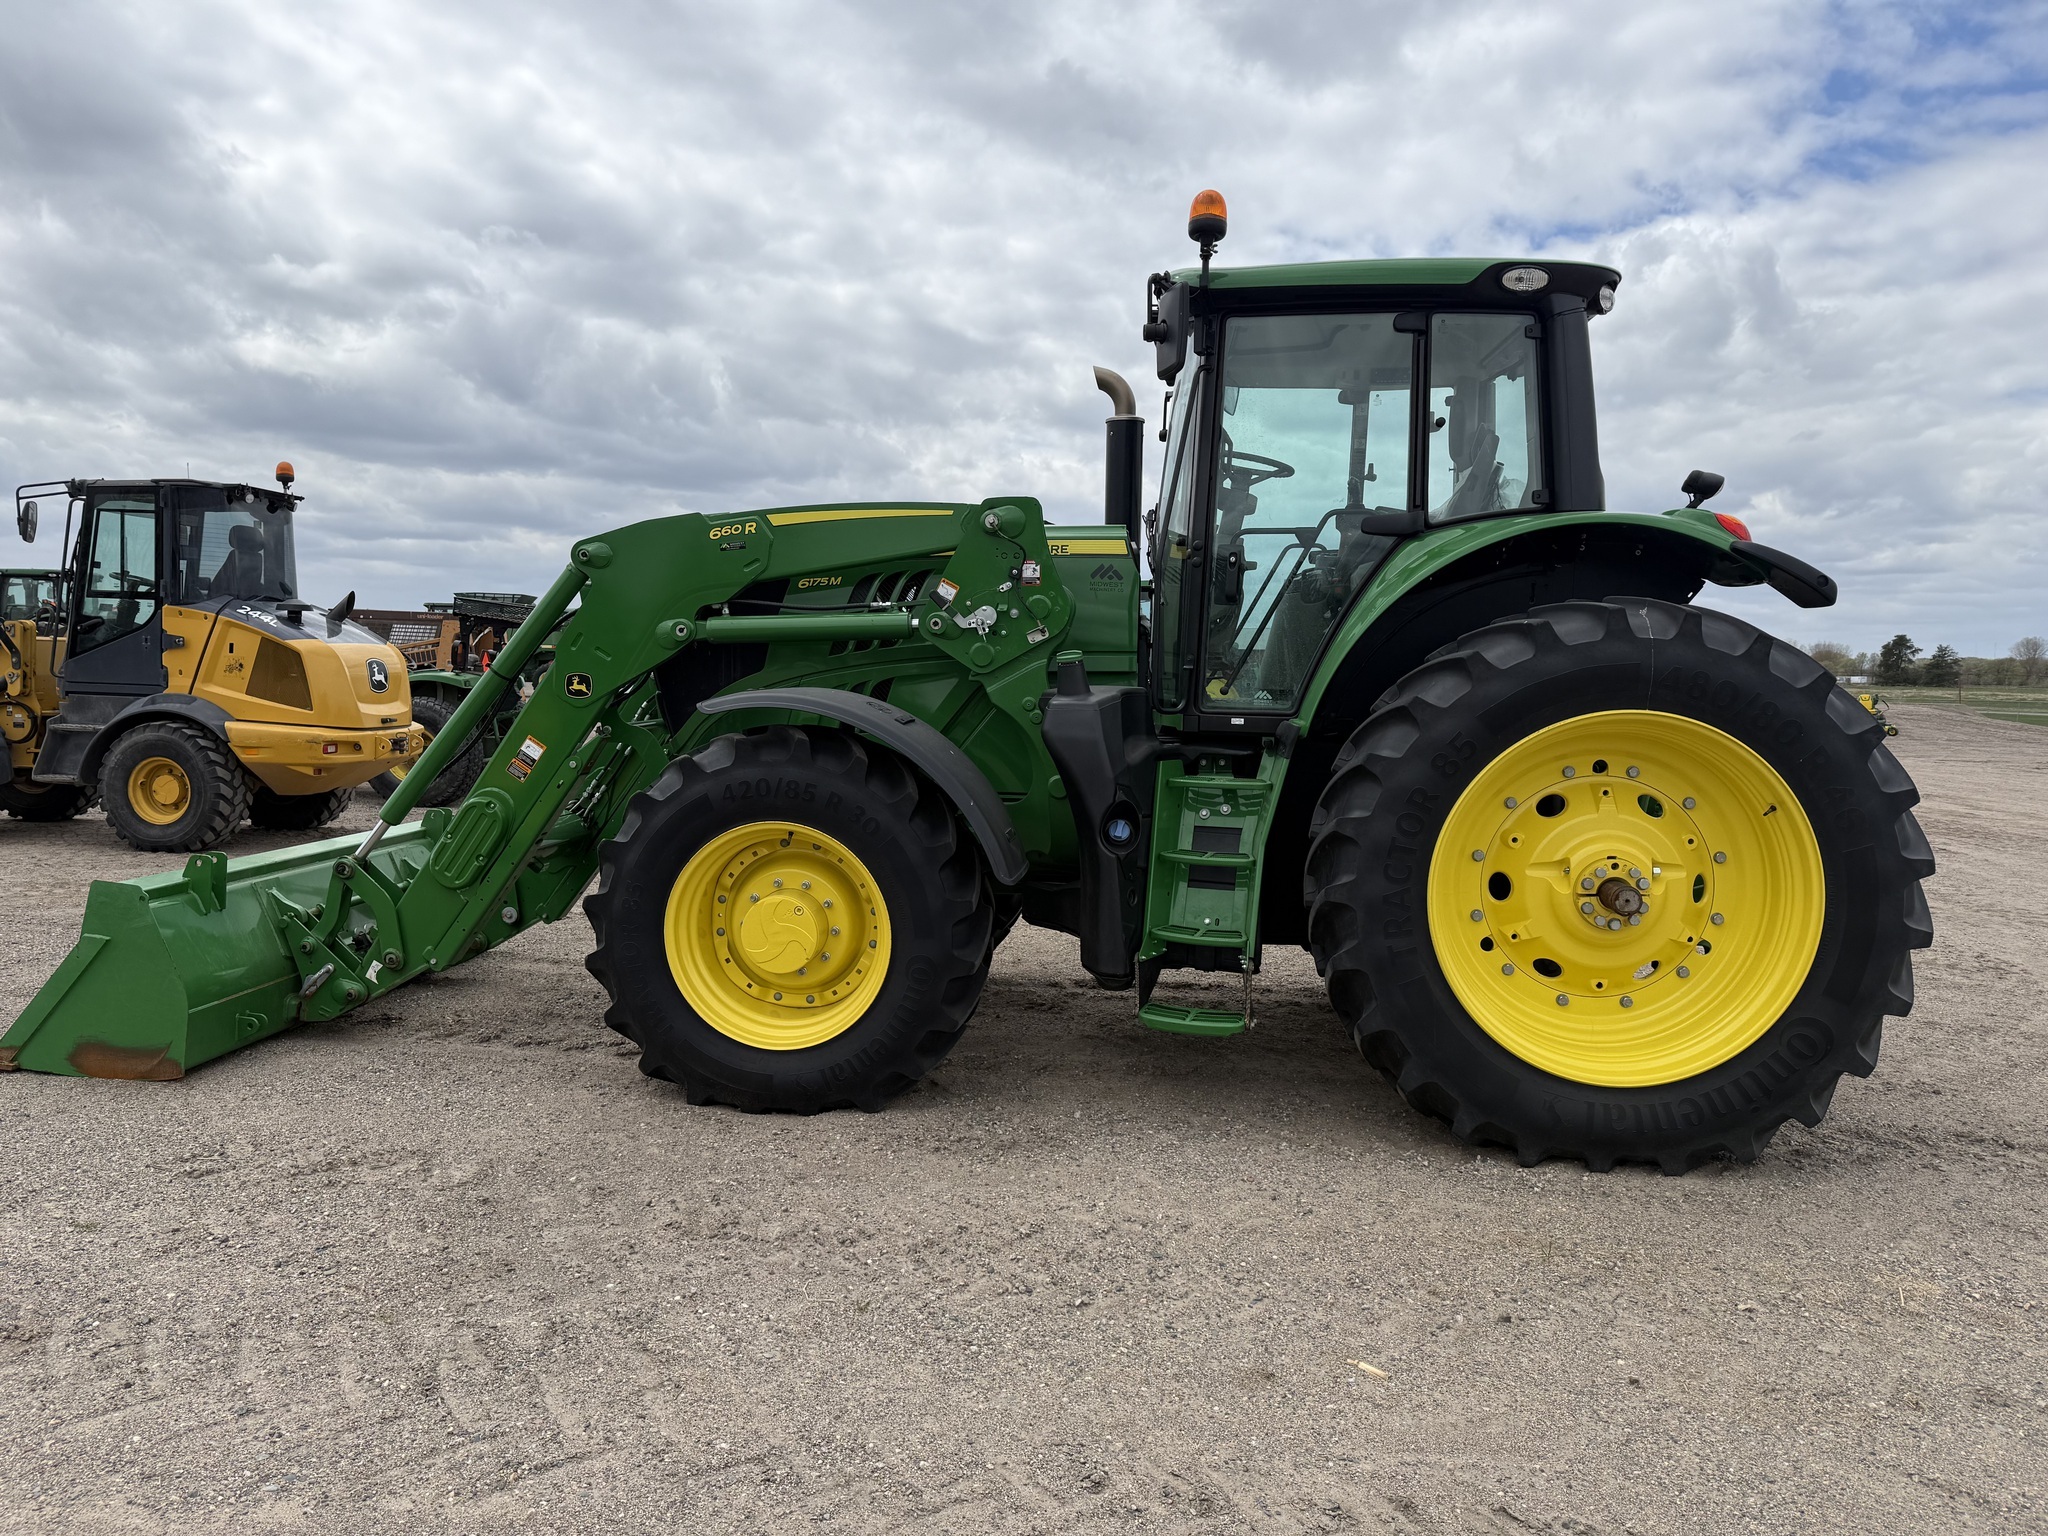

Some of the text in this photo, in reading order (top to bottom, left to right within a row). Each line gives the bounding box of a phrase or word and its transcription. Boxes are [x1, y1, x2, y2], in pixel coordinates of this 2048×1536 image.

[236, 605, 278, 628] 244L
[721, 776, 881, 836] 420/85 R 30
[1383, 729, 1478, 960] TRACTOR 85
[621, 879, 645, 912] 85
[1583, 1016, 1835, 1136] Continental
